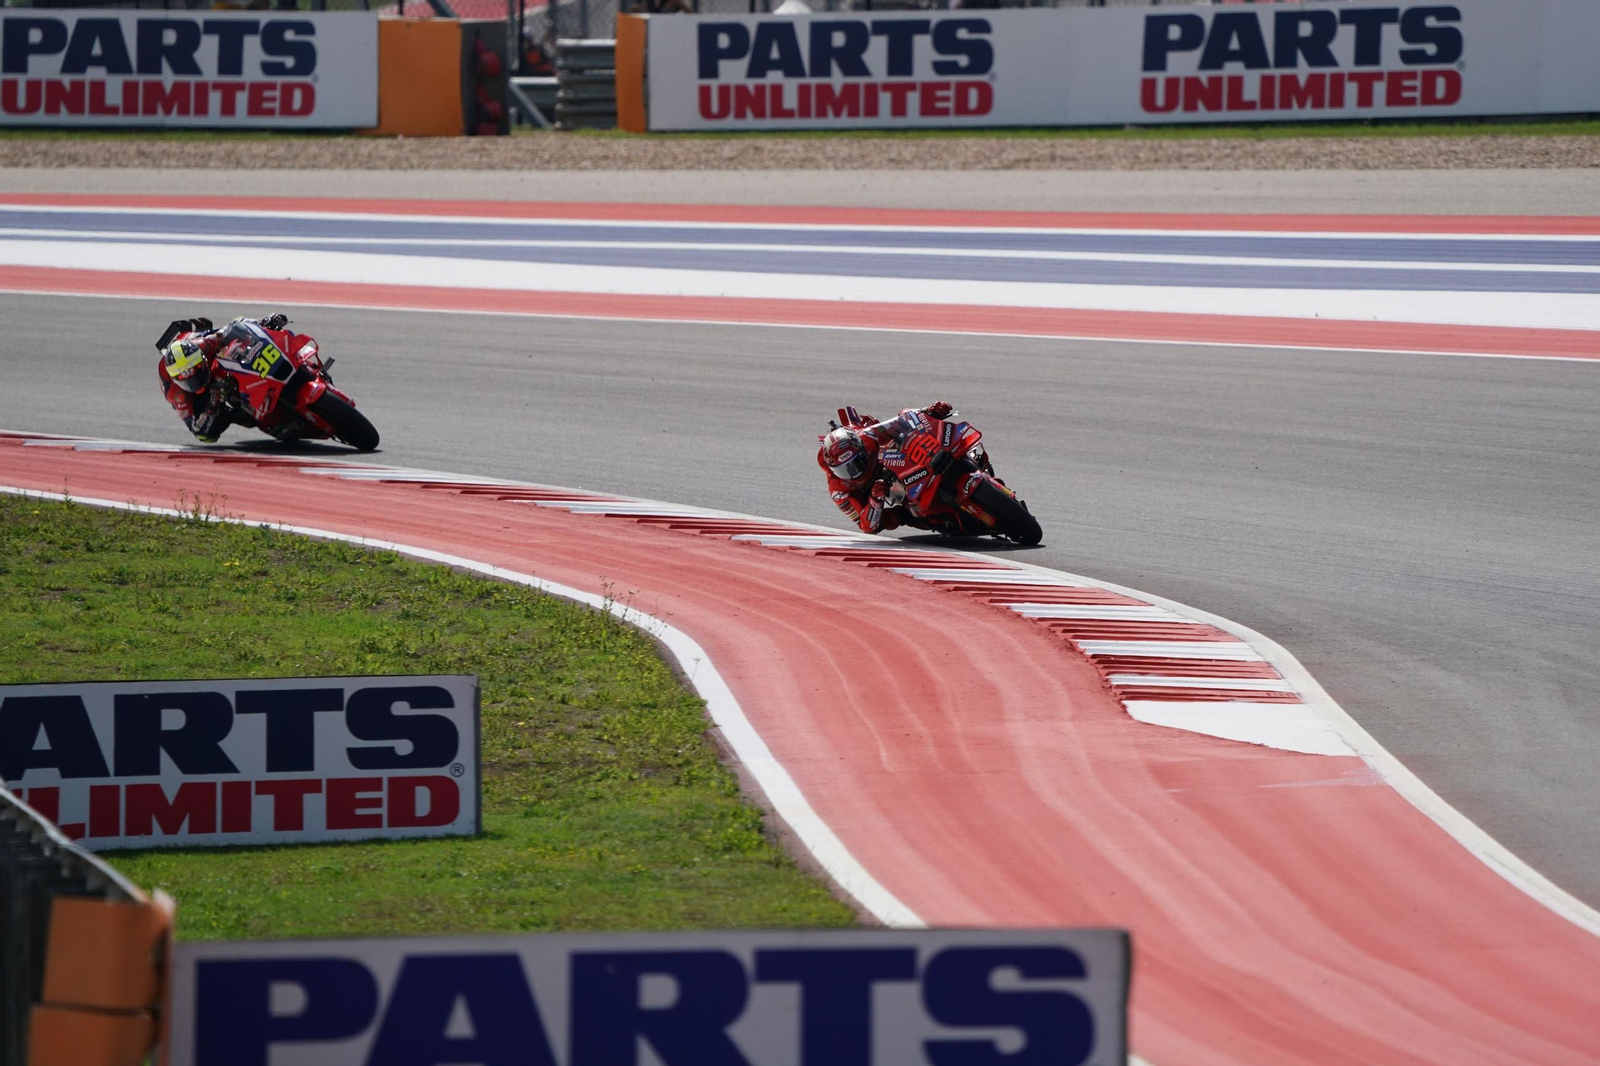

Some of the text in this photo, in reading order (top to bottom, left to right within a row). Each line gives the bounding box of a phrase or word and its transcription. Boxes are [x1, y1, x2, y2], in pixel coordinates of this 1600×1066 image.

[2, 17, 316, 77] PARTS
[697, 18, 995, 79] PARTS
[1142, 6, 1463, 71] PARTS
[1, 78, 316, 118] UNLIMITED
[698, 80, 995, 121] UNLIMITED
[1140, 69, 1463, 114] UNLIMITED
[252, 343, 281, 379] 36
[910, 434, 941, 466] 93
[943, 423, 952, 447] Lenovo
[904, 470, 927, 485] Lenovo
[0, 685, 459, 781] ARTS
[12, 775, 460, 841] LIMITED
[195, 945, 1097, 1066] PARTS
